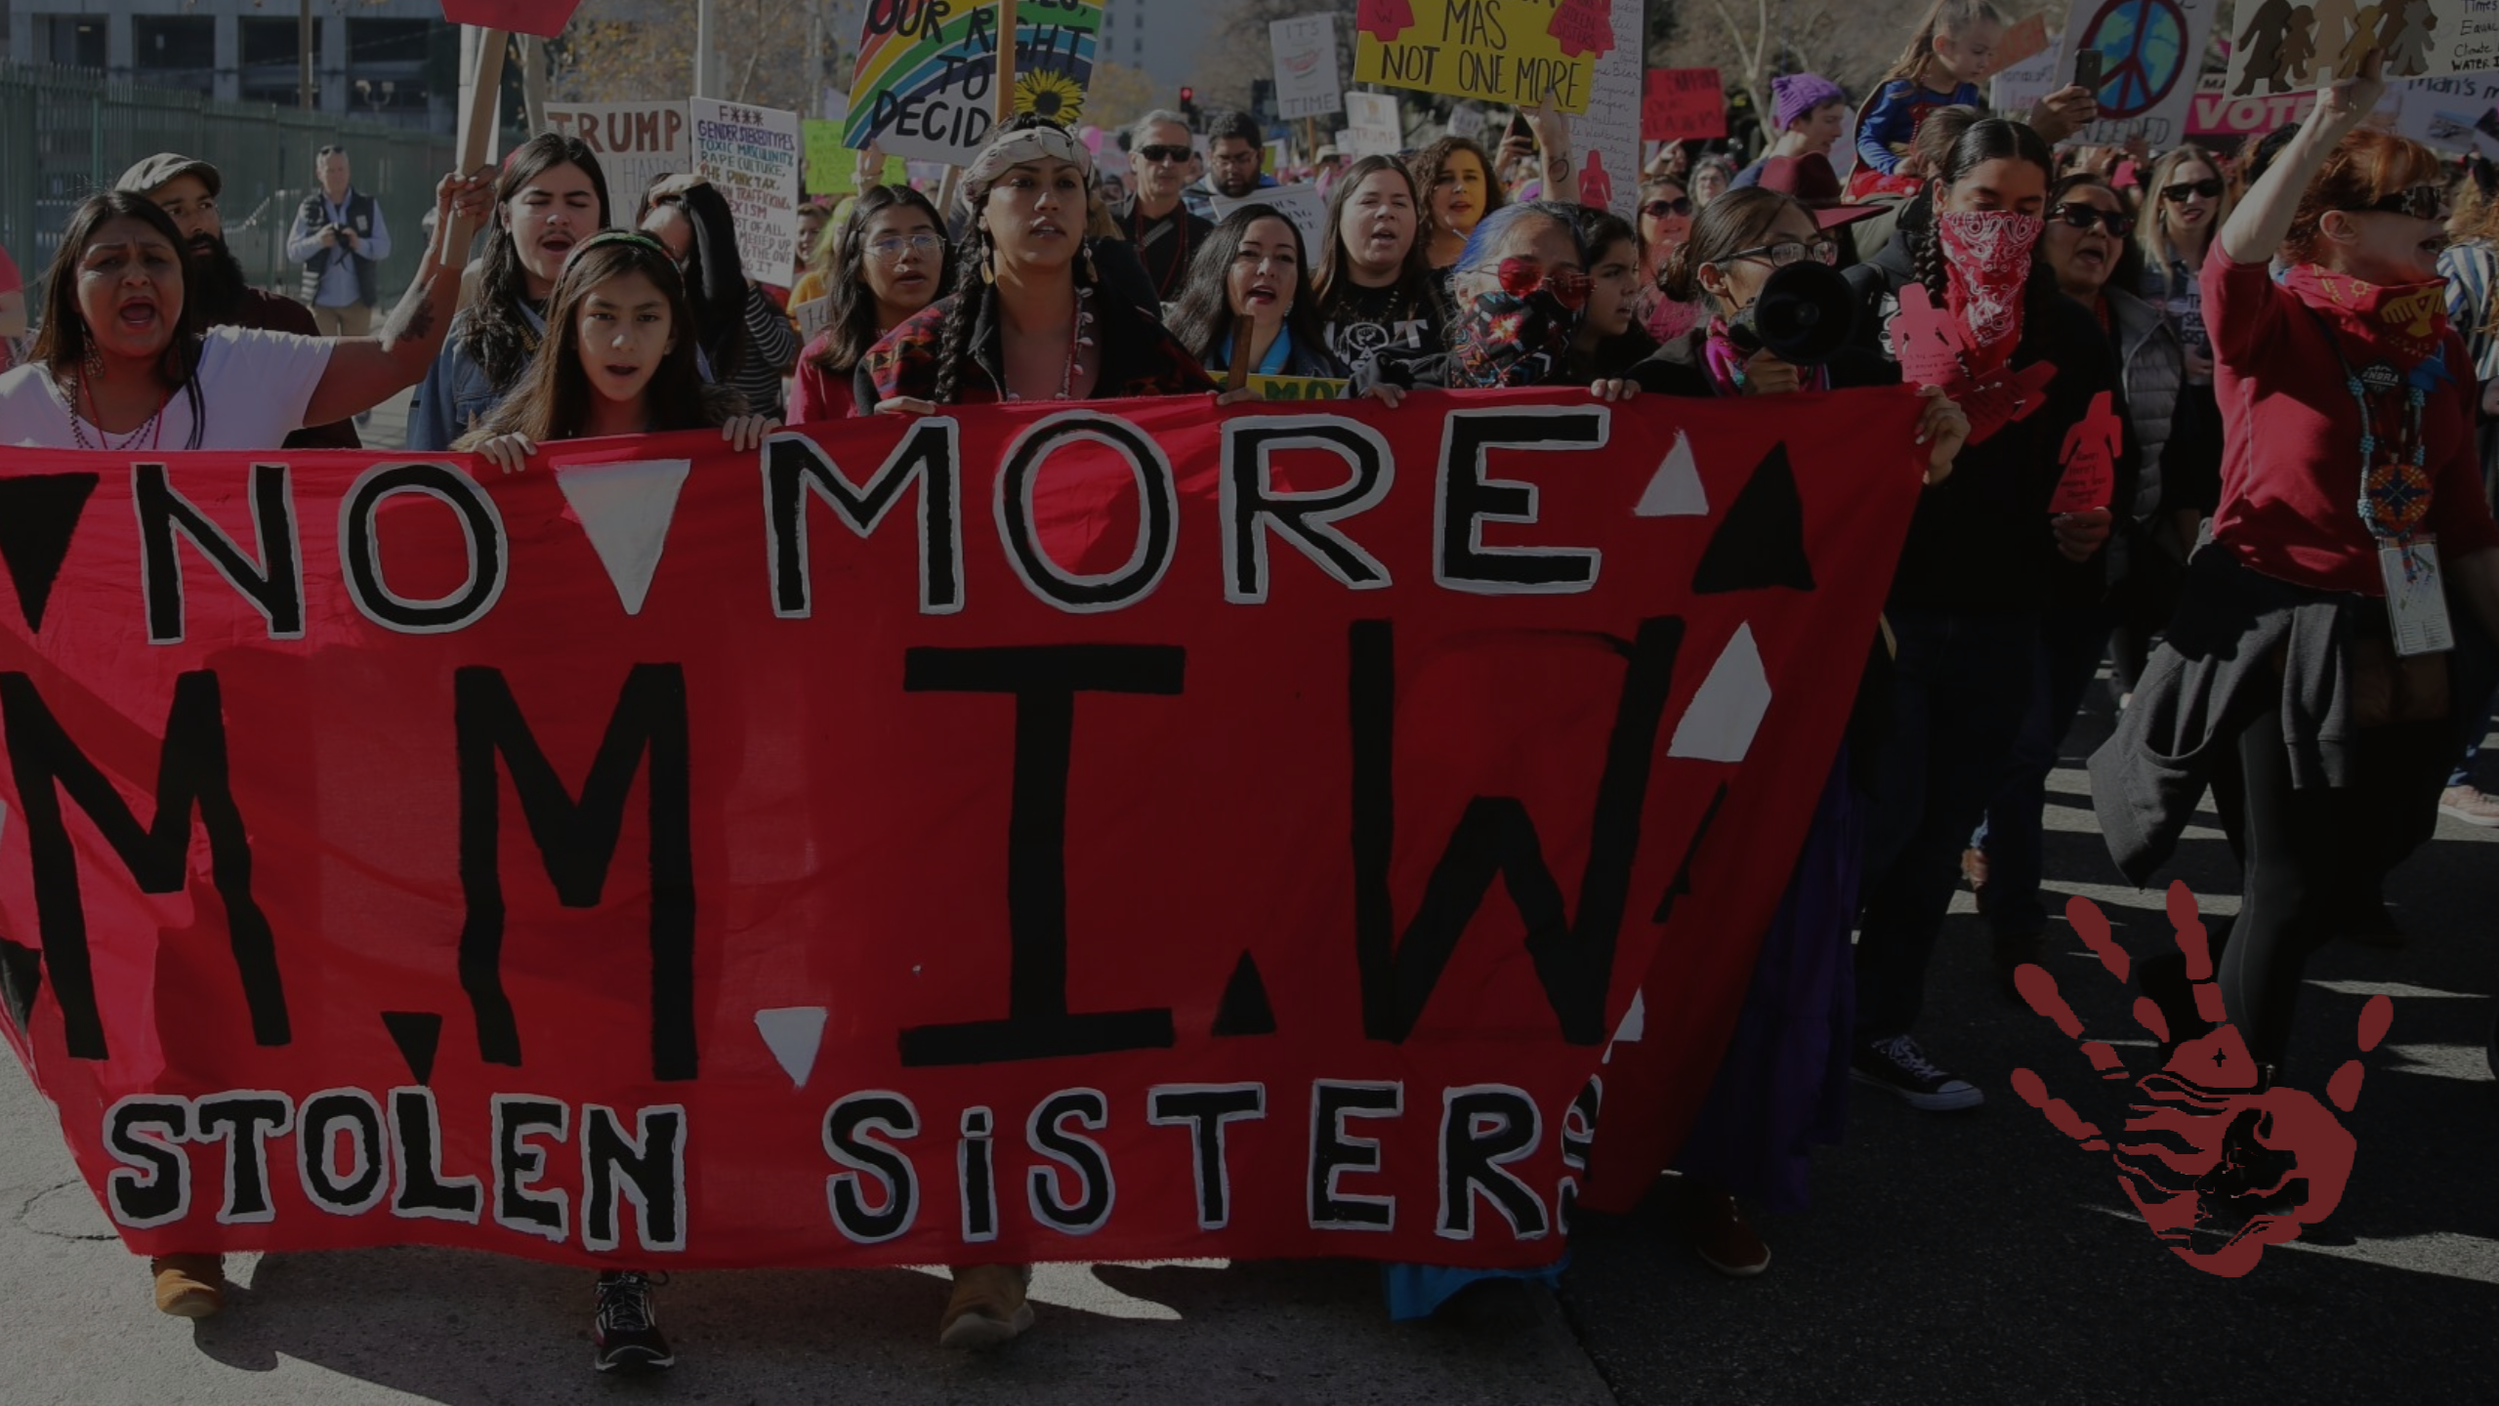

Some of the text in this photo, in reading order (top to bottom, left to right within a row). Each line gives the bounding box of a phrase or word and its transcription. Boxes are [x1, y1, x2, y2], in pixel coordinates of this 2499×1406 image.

[867, 0, 950, 44] OUR
[937, 54, 990, 101] TO
[1381, 44, 1440, 85] NOT
[1458, 50, 1507, 94] ONE
[1515, 57, 1582, 108] MORE
[2451, 58, 2491, 72] WATER
[870, 89, 992, 148] DECID
[1284, 93, 1336, 115] TIME
[547, 108, 682, 153] TRUMP
[697, 119, 738, 142] GENDER
[698, 137, 734, 154] TOXIC
[701, 151, 735, 168] RAPE
[728, 199, 768, 220] EXISM
[777, 238, 793, 252] UP
[130, 404, 1610, 645] NO MORE
[104, 1084, 687, 1254] STOLEN
